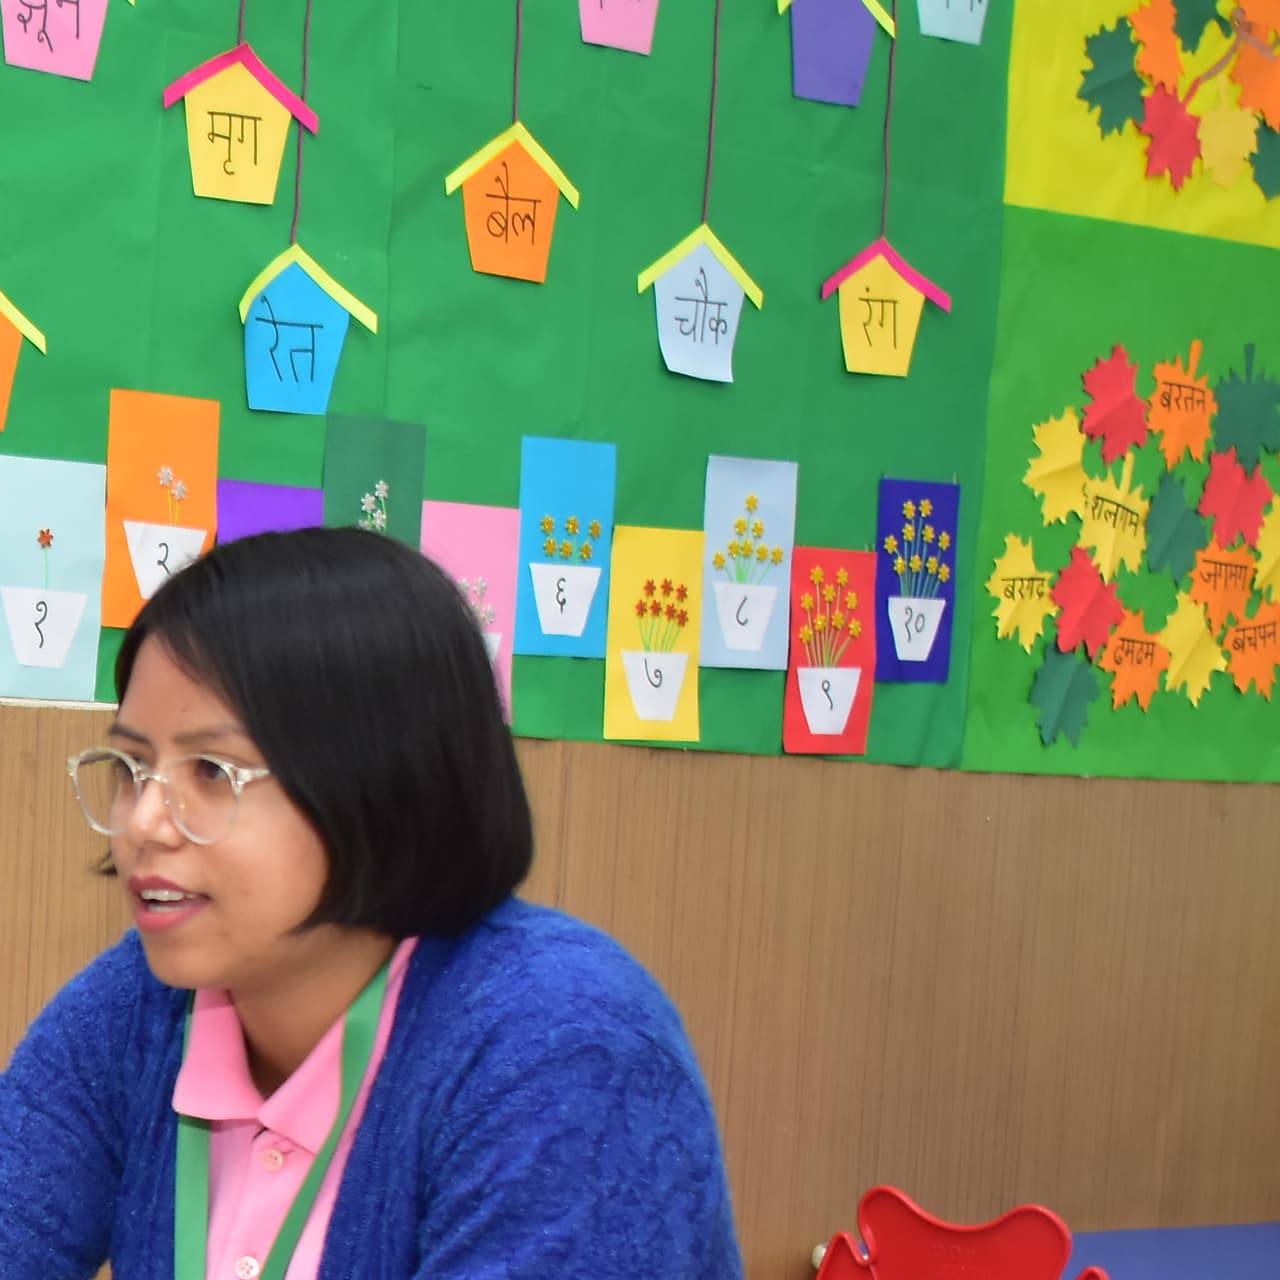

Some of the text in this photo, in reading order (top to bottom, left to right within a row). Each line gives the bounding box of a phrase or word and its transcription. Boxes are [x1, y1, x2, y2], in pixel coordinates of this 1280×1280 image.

[207, 111, 262, 175] मृग
[485, 161, 541, 245] बेल
[674, 267, 728, 344] चोक
[858, 287, 899, 348] रंग
[256, 295, 324, 383] रेत
[1160, 381, 1206, 412] बरतन
[1090, 496, 1140, 537] शलगम
[1001, 577, 1046, 600] बरगद
[35, 600, 48, 648] १
[1233, 621, 1277, 654] बचपन
